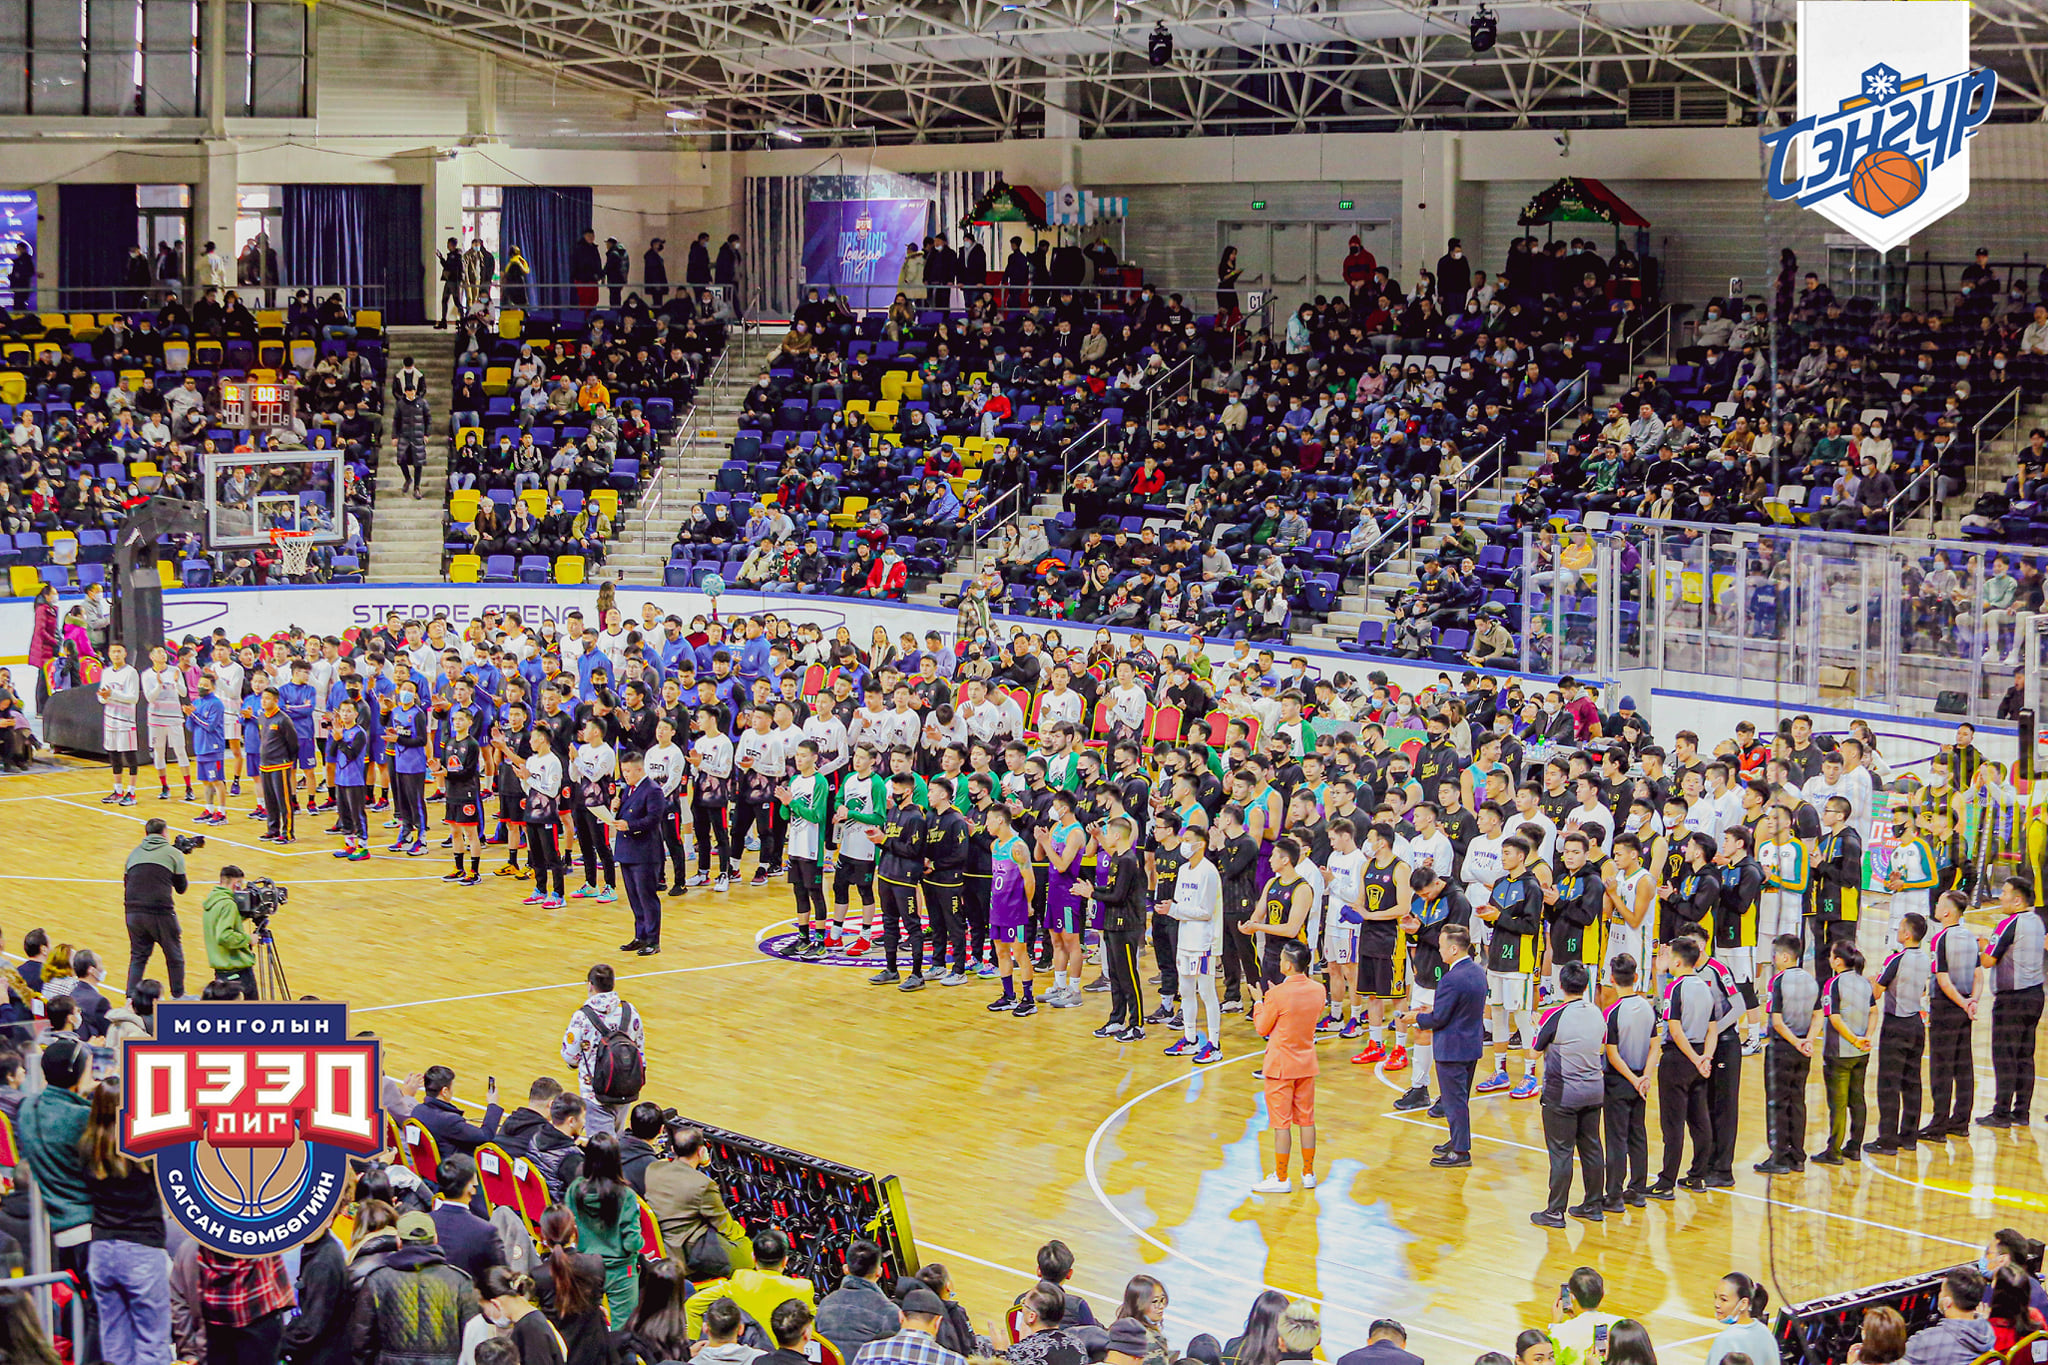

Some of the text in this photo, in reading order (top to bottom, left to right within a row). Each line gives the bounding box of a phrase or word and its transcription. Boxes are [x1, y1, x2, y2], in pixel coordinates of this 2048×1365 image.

[840, 242, 882, 274] League
[1250, 295, 1261, 309] C1
[1101, 854, 1109, 867] 6
[994, 875, 1004, 890] 0
[1007, 927, 1015, 938] 0
[1501, 944, 1514, 959] 24
[1566, 938, 1577, 952] 15
[1434, 966, 1442, 982] 9
